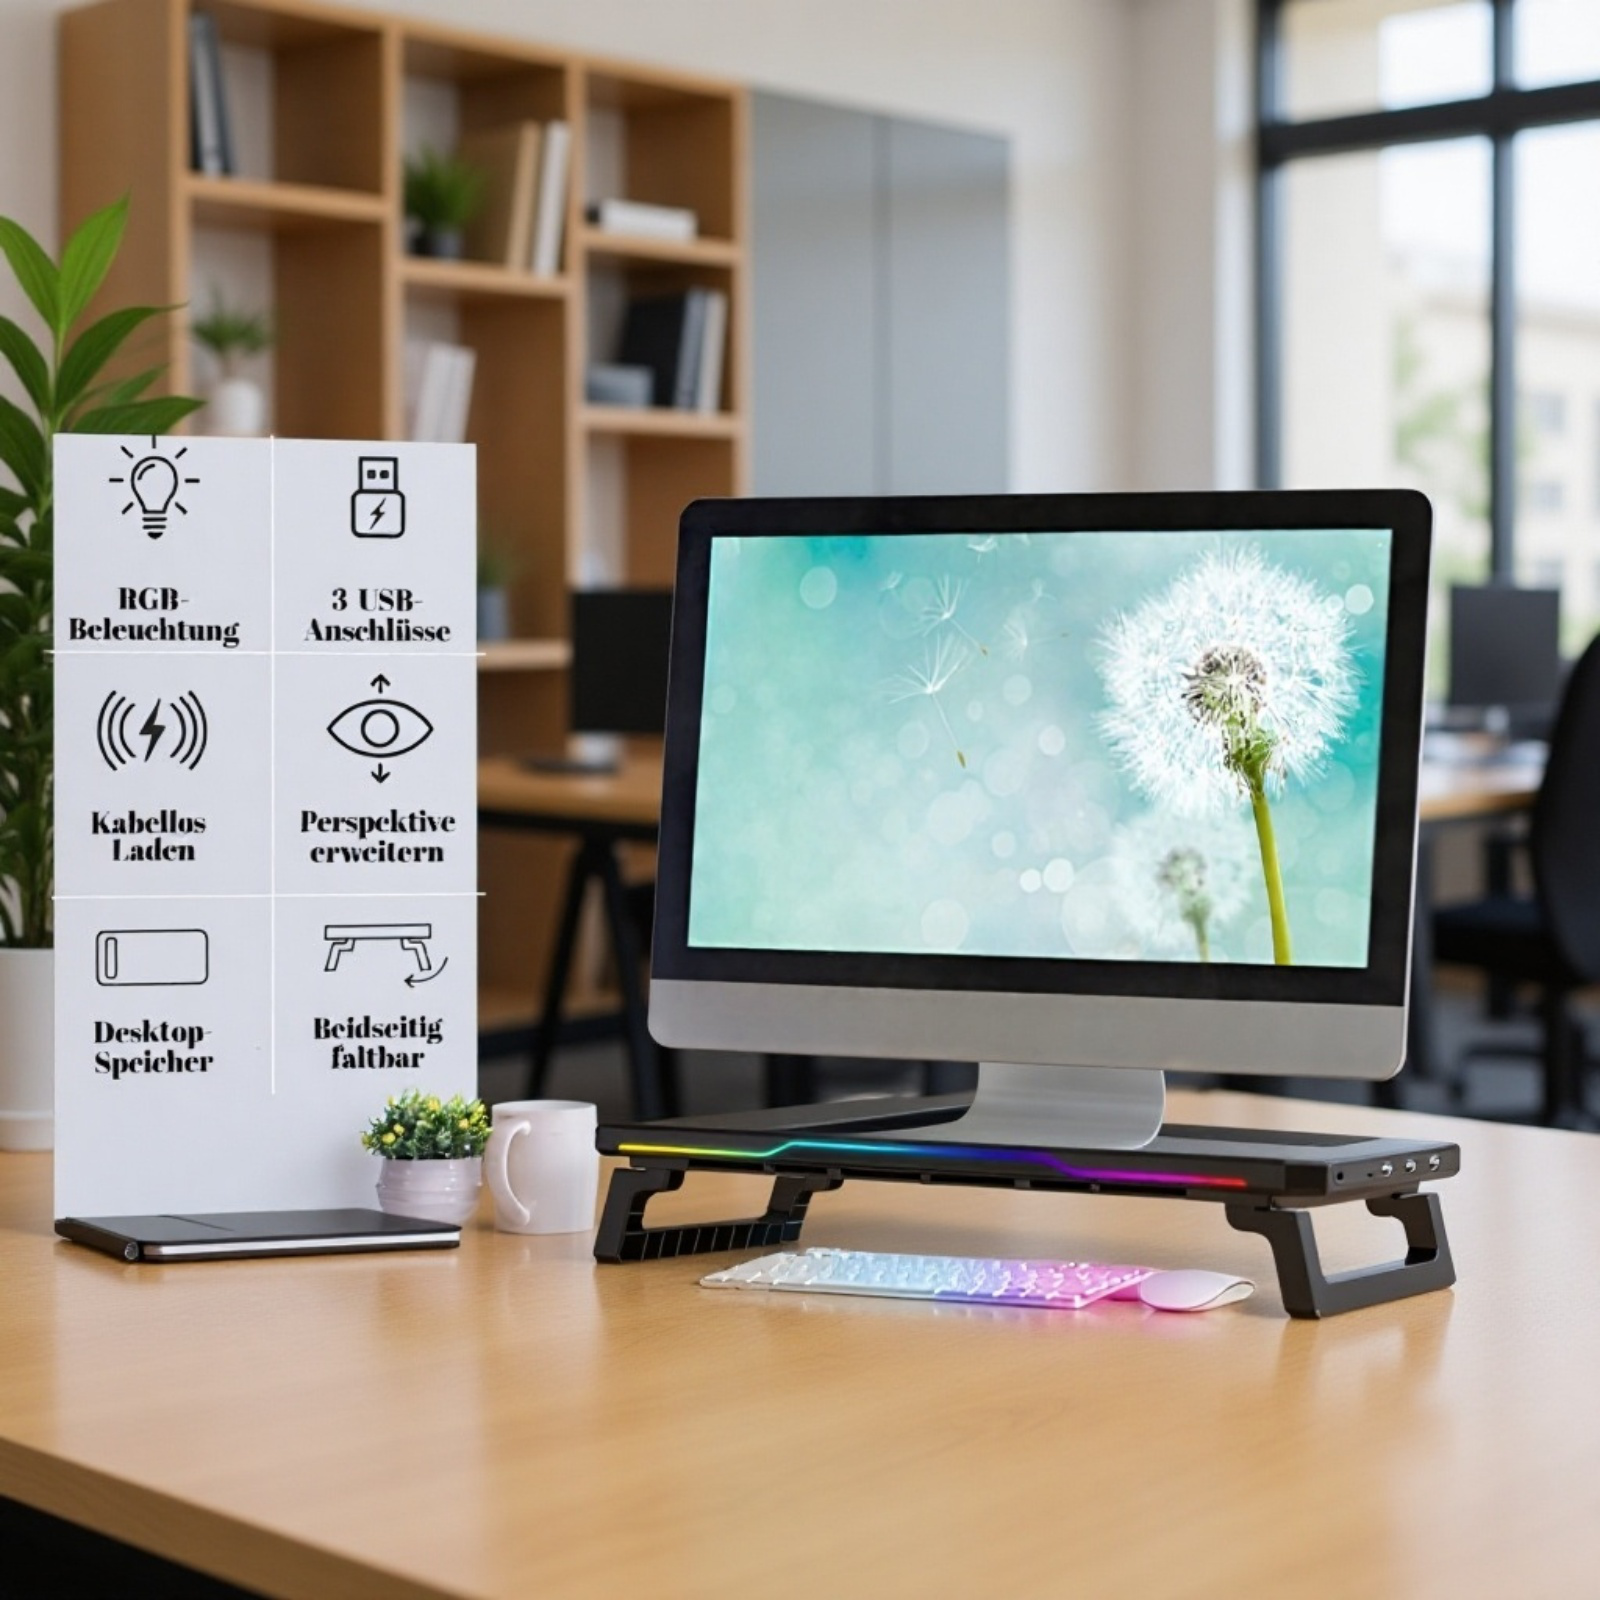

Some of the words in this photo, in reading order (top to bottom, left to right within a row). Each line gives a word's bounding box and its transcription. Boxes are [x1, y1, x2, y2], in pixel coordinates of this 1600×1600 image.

[118, 587, 190, 611] RGB-
[331, 588, 348, 612] 3
[358, 588, 424, 612] USB-
[69, 617, 240, 648] Beleuchtung
[304, 618, 451, 643] Anschlüsse
[91, 809, 207, 835] Kabellos
[300, 809, 456, 839] Perspektive
[112, 836, 196, 862] Laden
[310, 839, 445, 863] erweitern
[94, 1019, 213, 1049] Desktop-
[314, 1015, 444, 1045] Beidseitig
[94, 1049, 214, 1080] Speicher
[331, 1045, 426, 1070] faltbar
